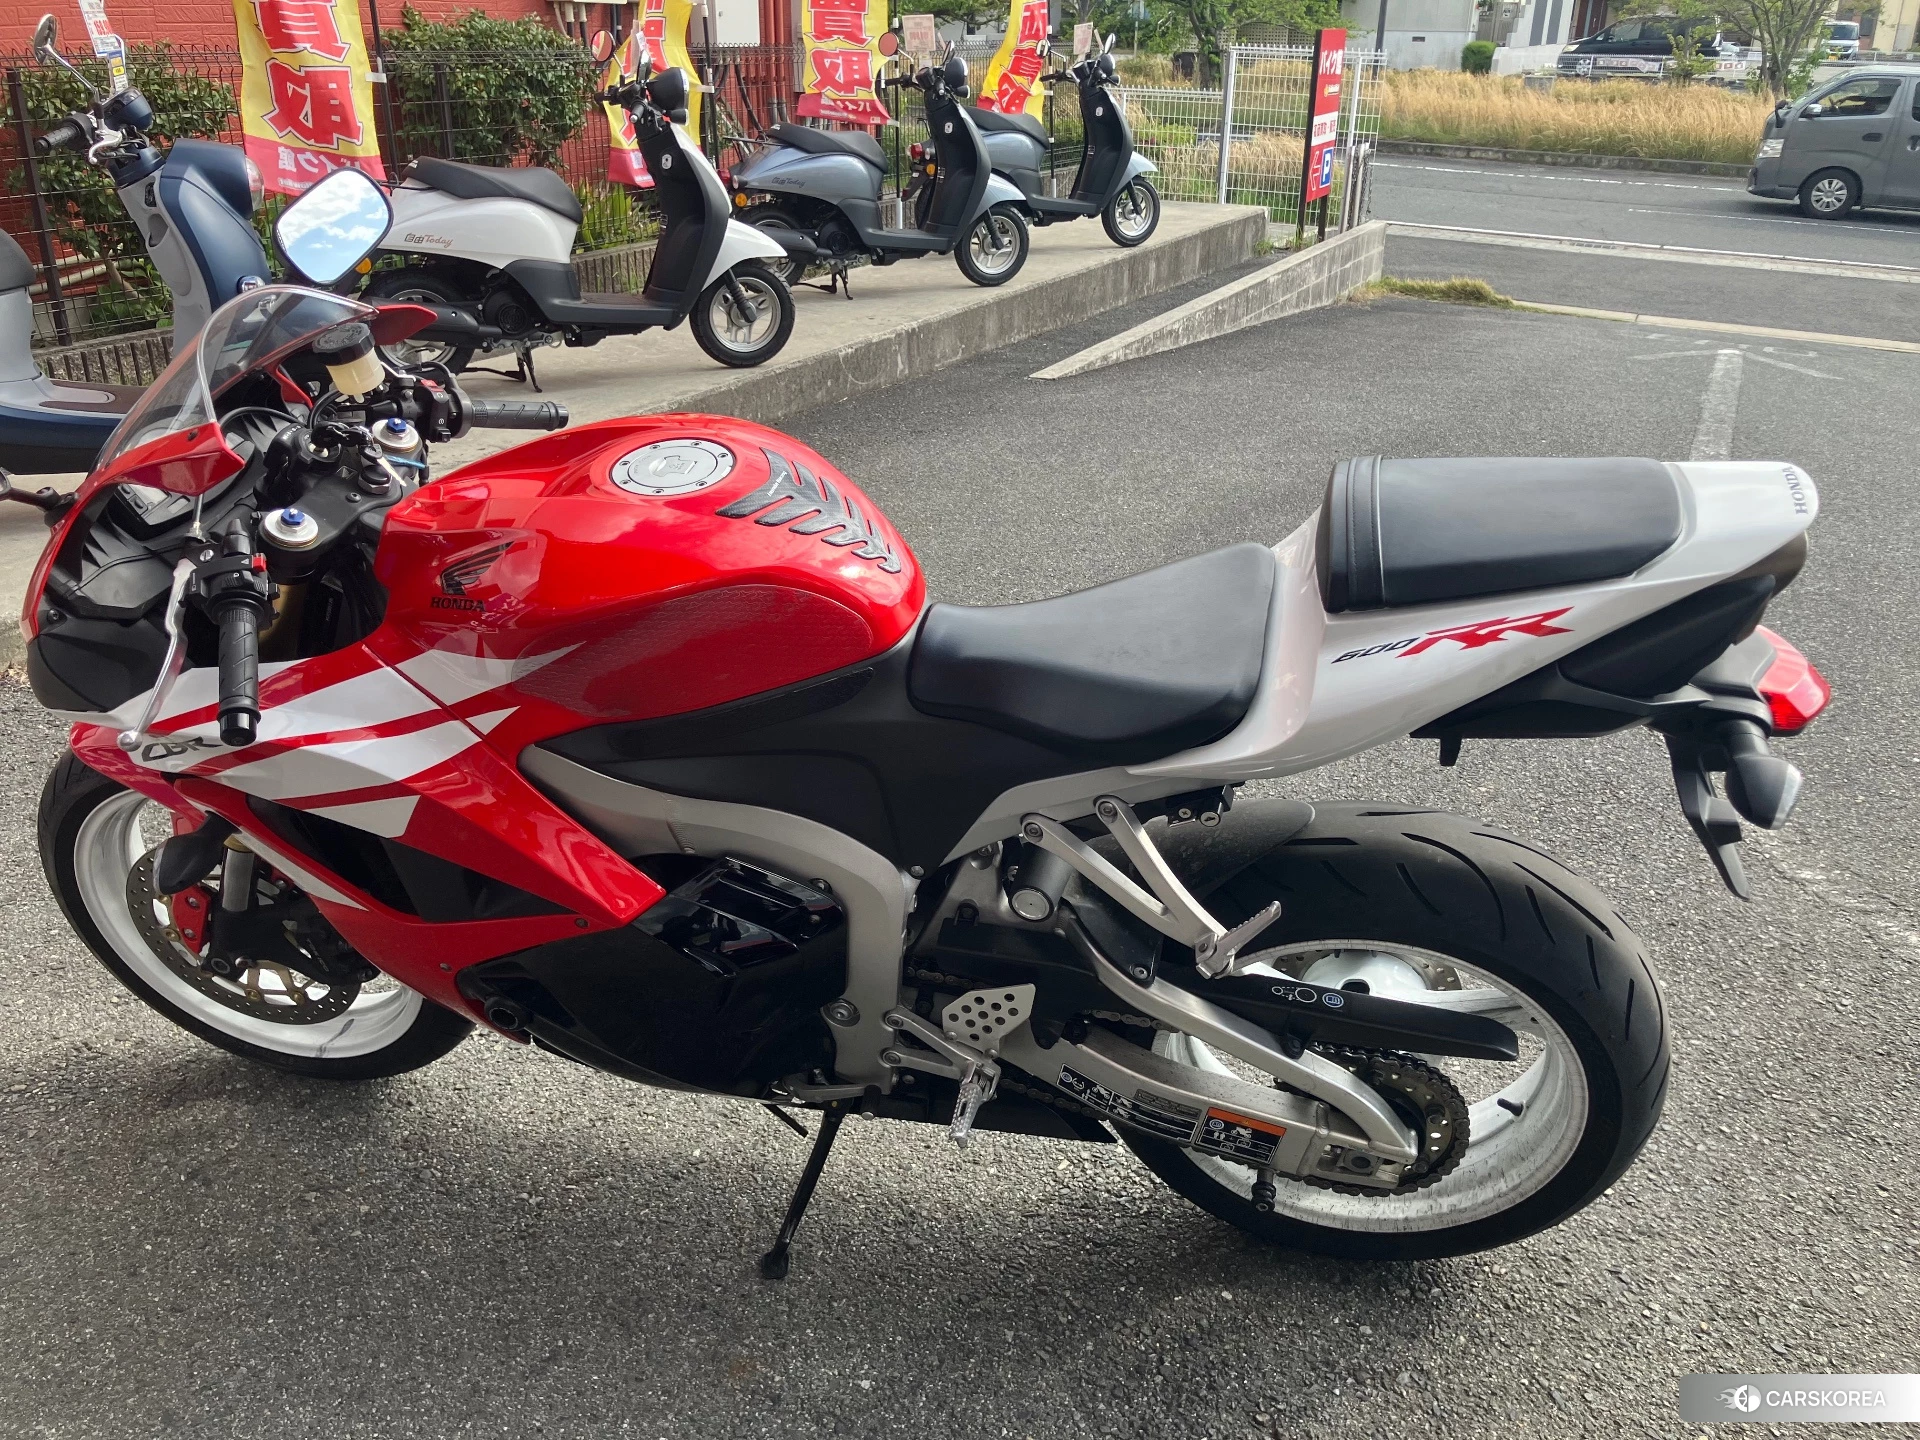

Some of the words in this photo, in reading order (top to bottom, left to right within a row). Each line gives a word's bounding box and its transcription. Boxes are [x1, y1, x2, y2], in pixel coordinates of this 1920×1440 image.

[1782, 466, 1808, 514] HONDA
[430, 597, 486, 612] HONDA
[141, 736, 223, 762] CBR
